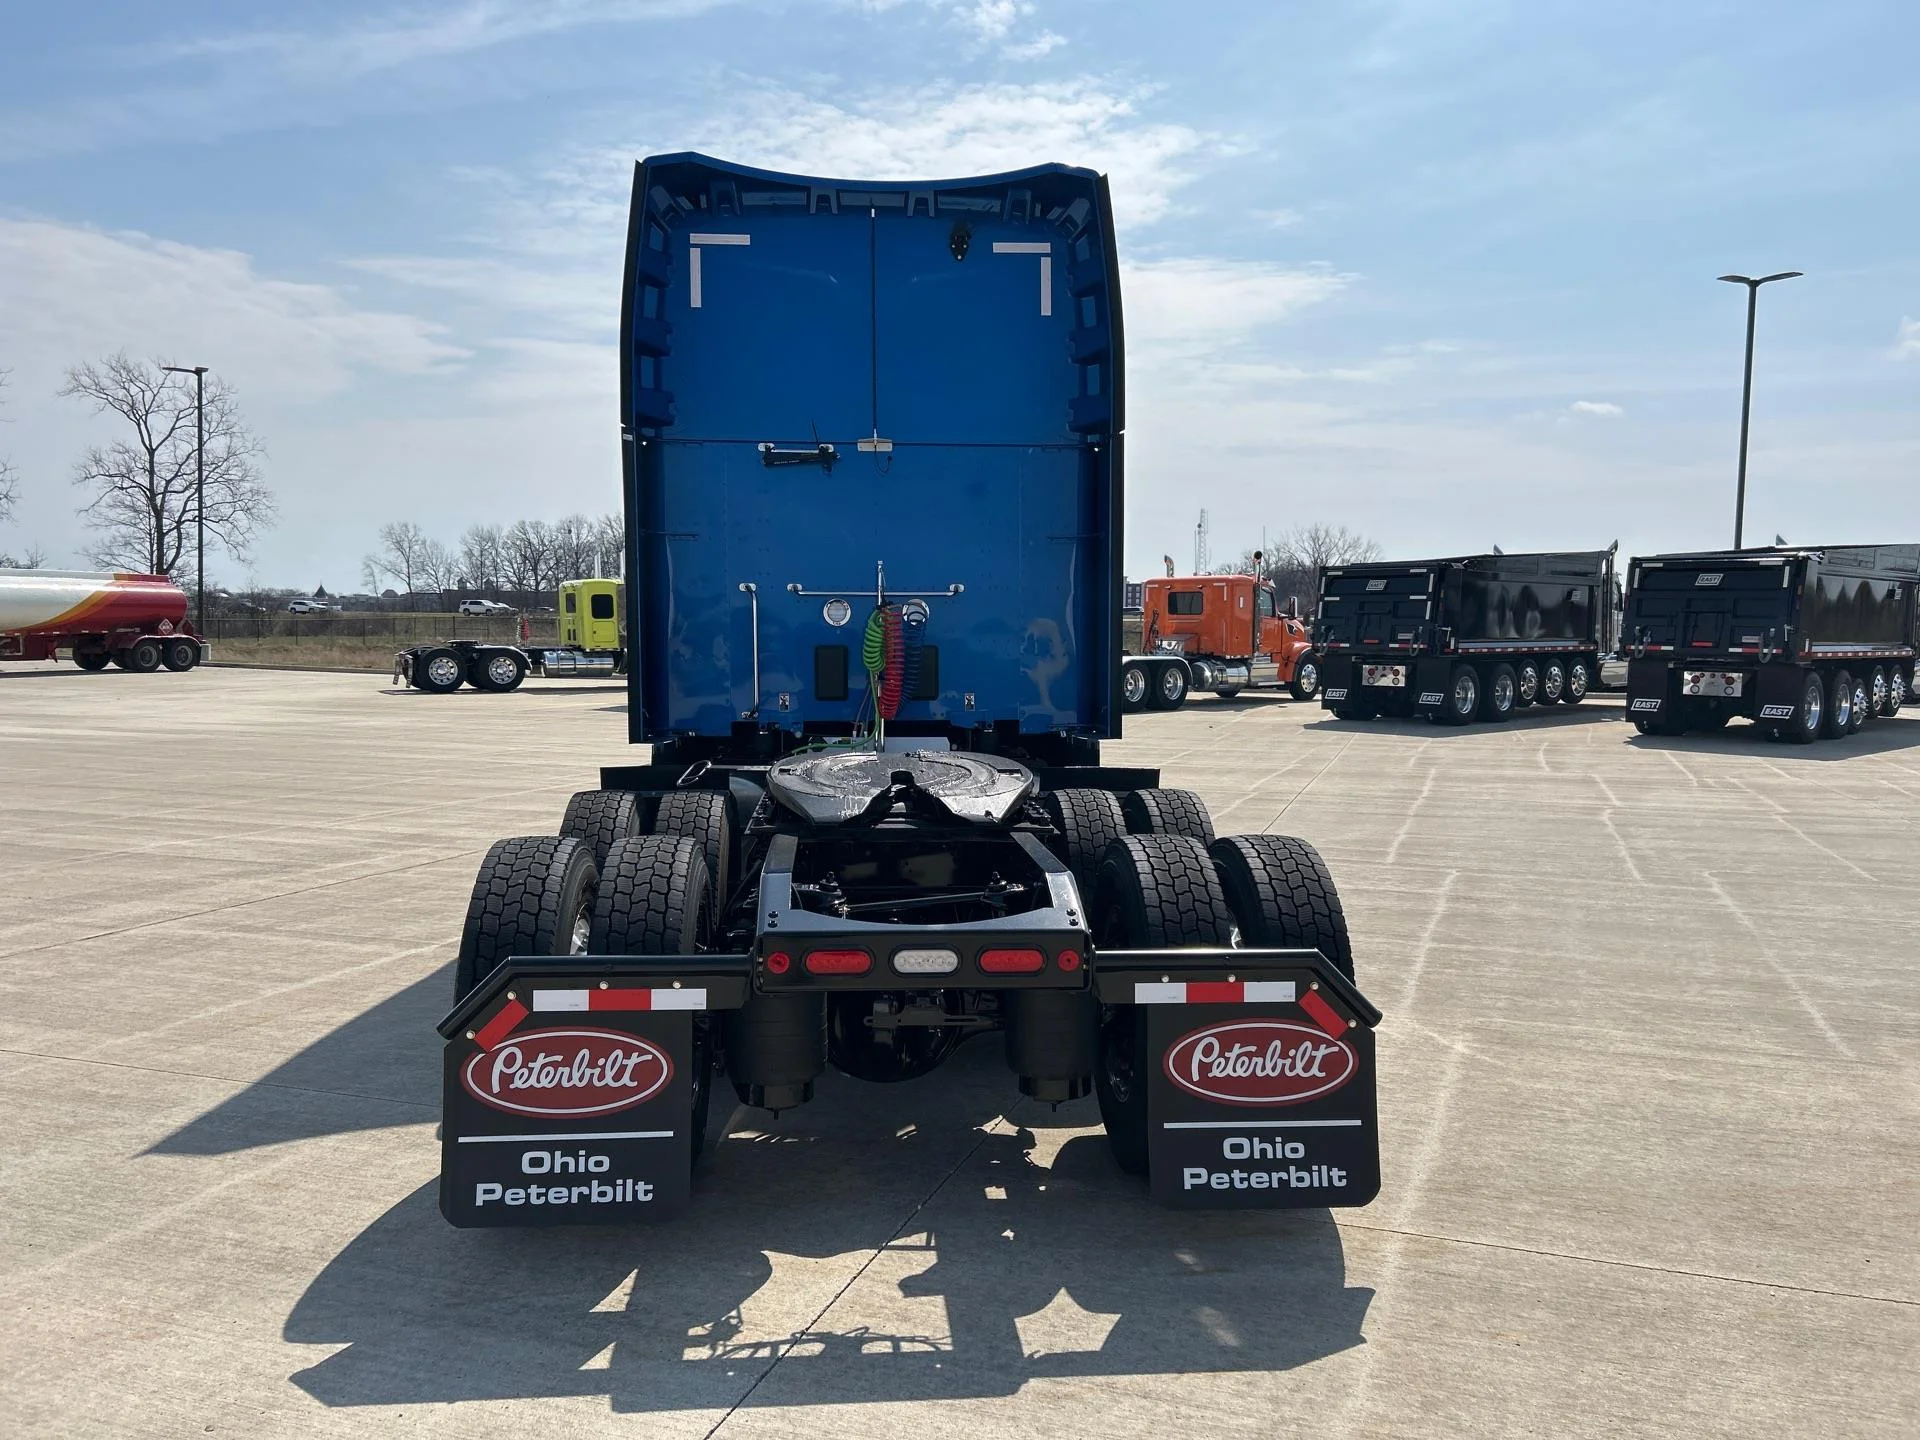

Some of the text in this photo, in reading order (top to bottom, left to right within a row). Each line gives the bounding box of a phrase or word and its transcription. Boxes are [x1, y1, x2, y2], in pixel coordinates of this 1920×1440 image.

[1698, 575, 1720, 584] EAST
[1634, 700, 1657, 708] EAST
[1764, 708, 1789, 716] EAST
[491, 1046, 653, 1094] Peterbilt
[1191, 1036, 1339, 1082] Peterbilt
[1223, 1136, 1305, 1160] Ohio
[521, 1150, 610, 1174] Ohio
[1183, 1165, 1347, 1190] Peterbilt
[475, 1179, 654, 1207] Peterbilt
